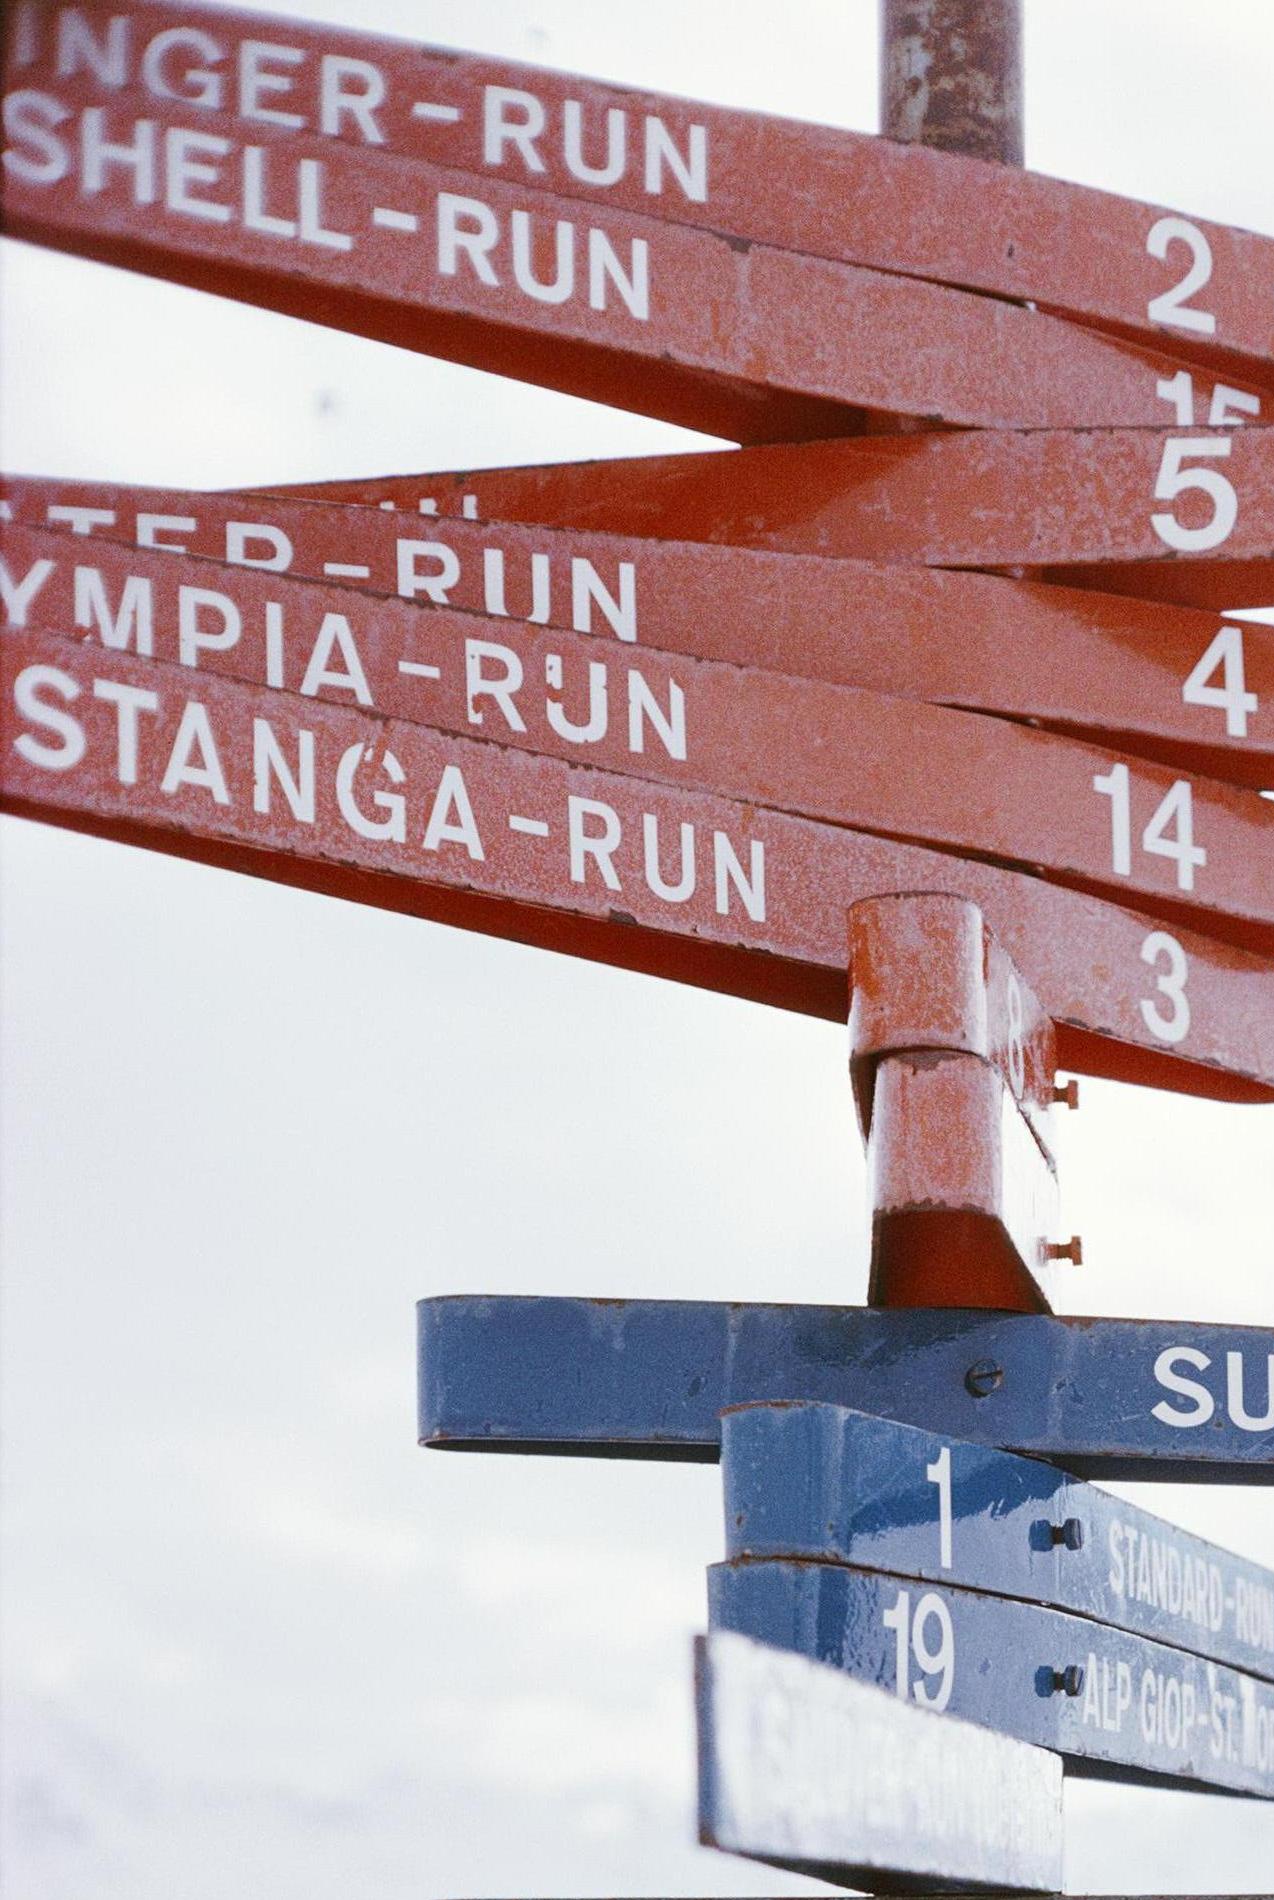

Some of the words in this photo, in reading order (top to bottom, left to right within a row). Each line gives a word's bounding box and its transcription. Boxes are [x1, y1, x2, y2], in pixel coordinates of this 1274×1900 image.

[2, 88, 650, 321] SHELL-RUN
[1146, 216, 1216, 334] 2
[1150, 436, 1239, 552] 5
[0, 558, 689, 761] YMPIA-RUN
[1093, 762, 1207, 892] 14
[1182, 626, 1258, 738] 4
[12, 664, 767, 923] STANGA-RUN
[1140, 931, 1192, 1044] 3
[926, 1446, 953, 1570] 1
[883, 1590, 955, 1711] 19
[1082, 1651, 1132, 1734] ALP
